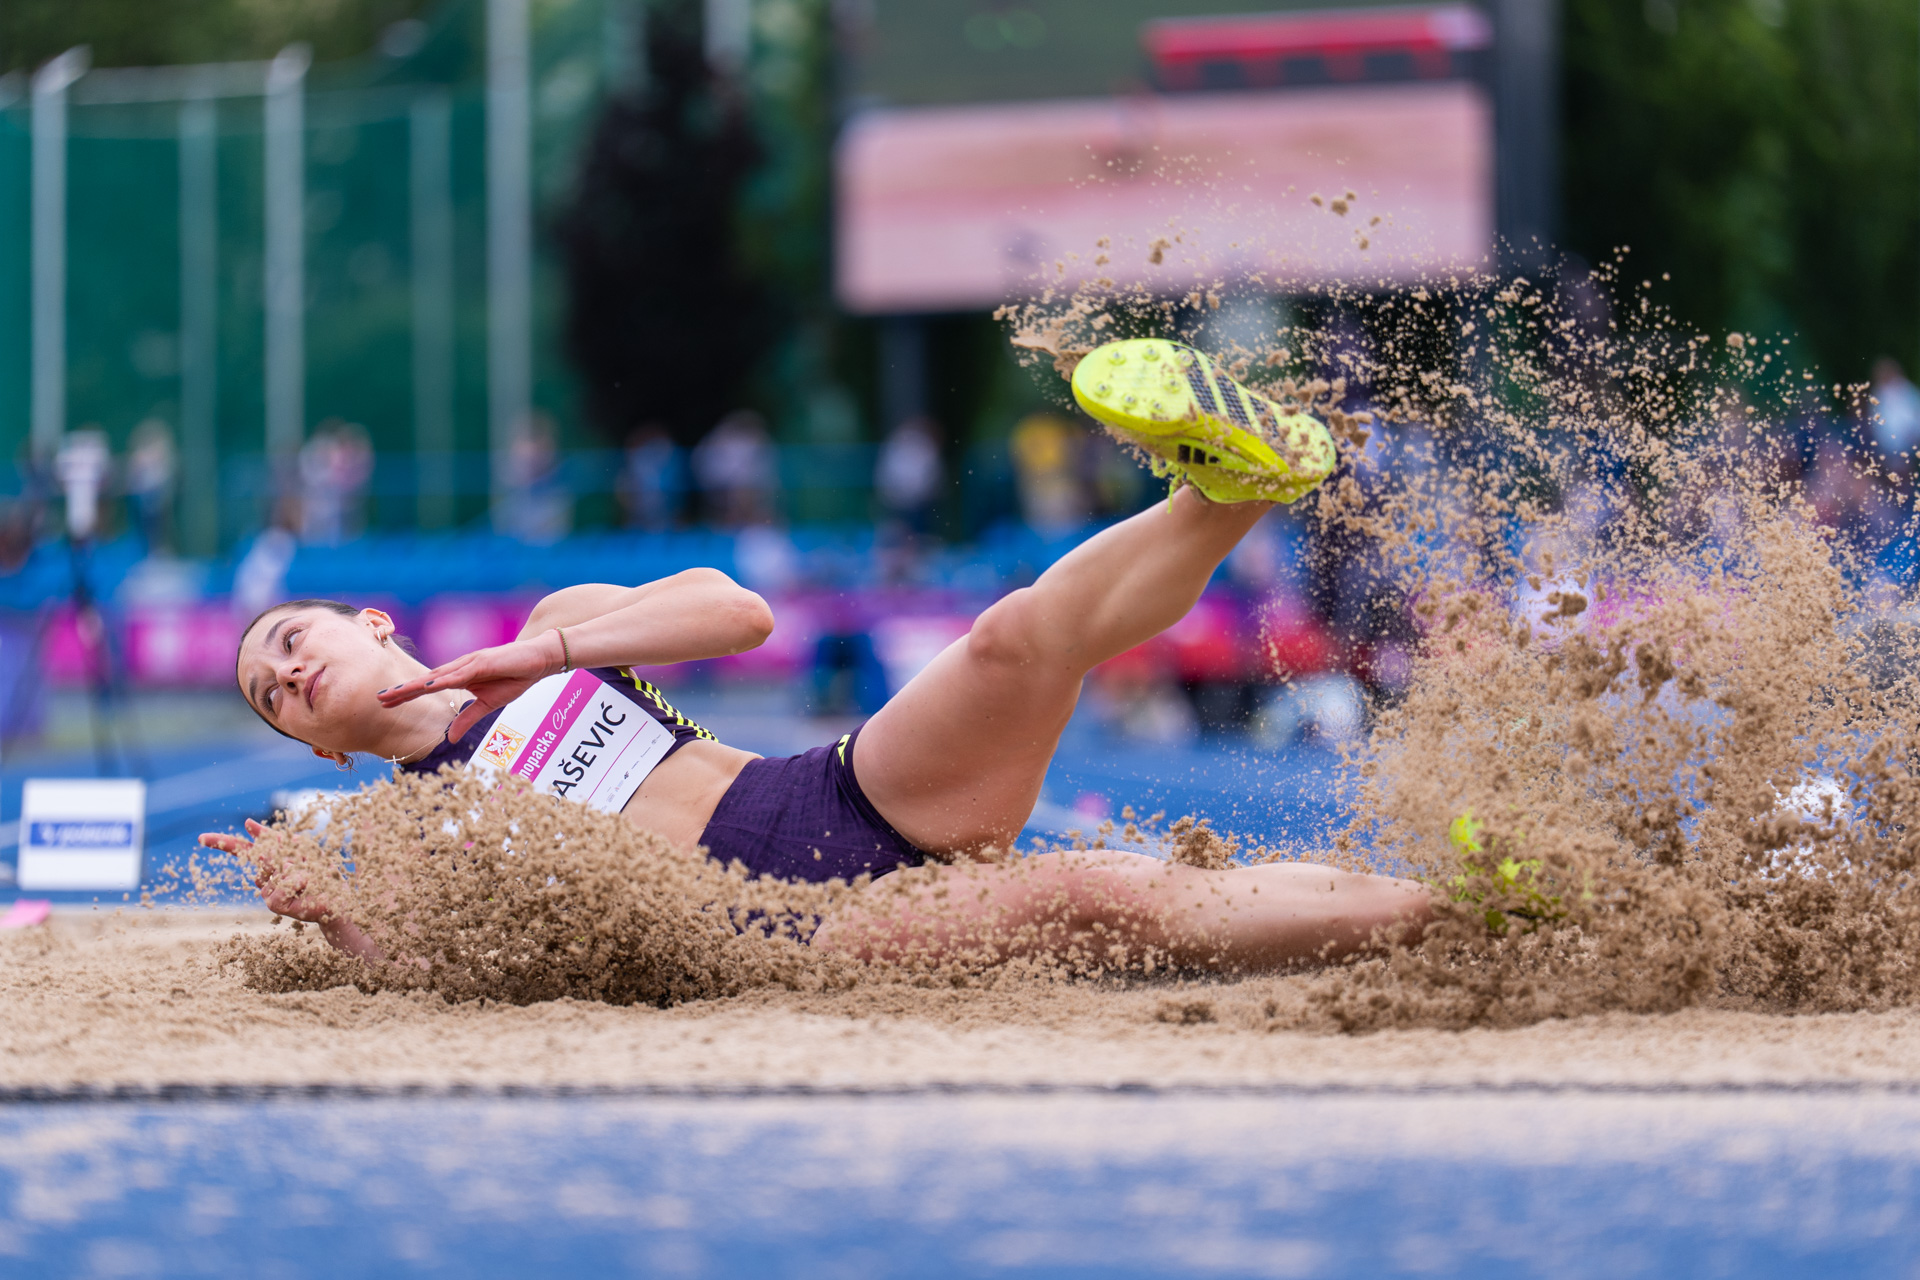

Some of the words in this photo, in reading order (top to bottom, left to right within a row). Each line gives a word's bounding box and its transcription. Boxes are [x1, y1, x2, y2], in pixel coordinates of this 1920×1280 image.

[498, 737, 524, 767] PZLA
[518, 731, 558, 779] nopacka
[552, 687, 583, 731] Classic
[550, 701, 626, 803] AŠEVIĆ
